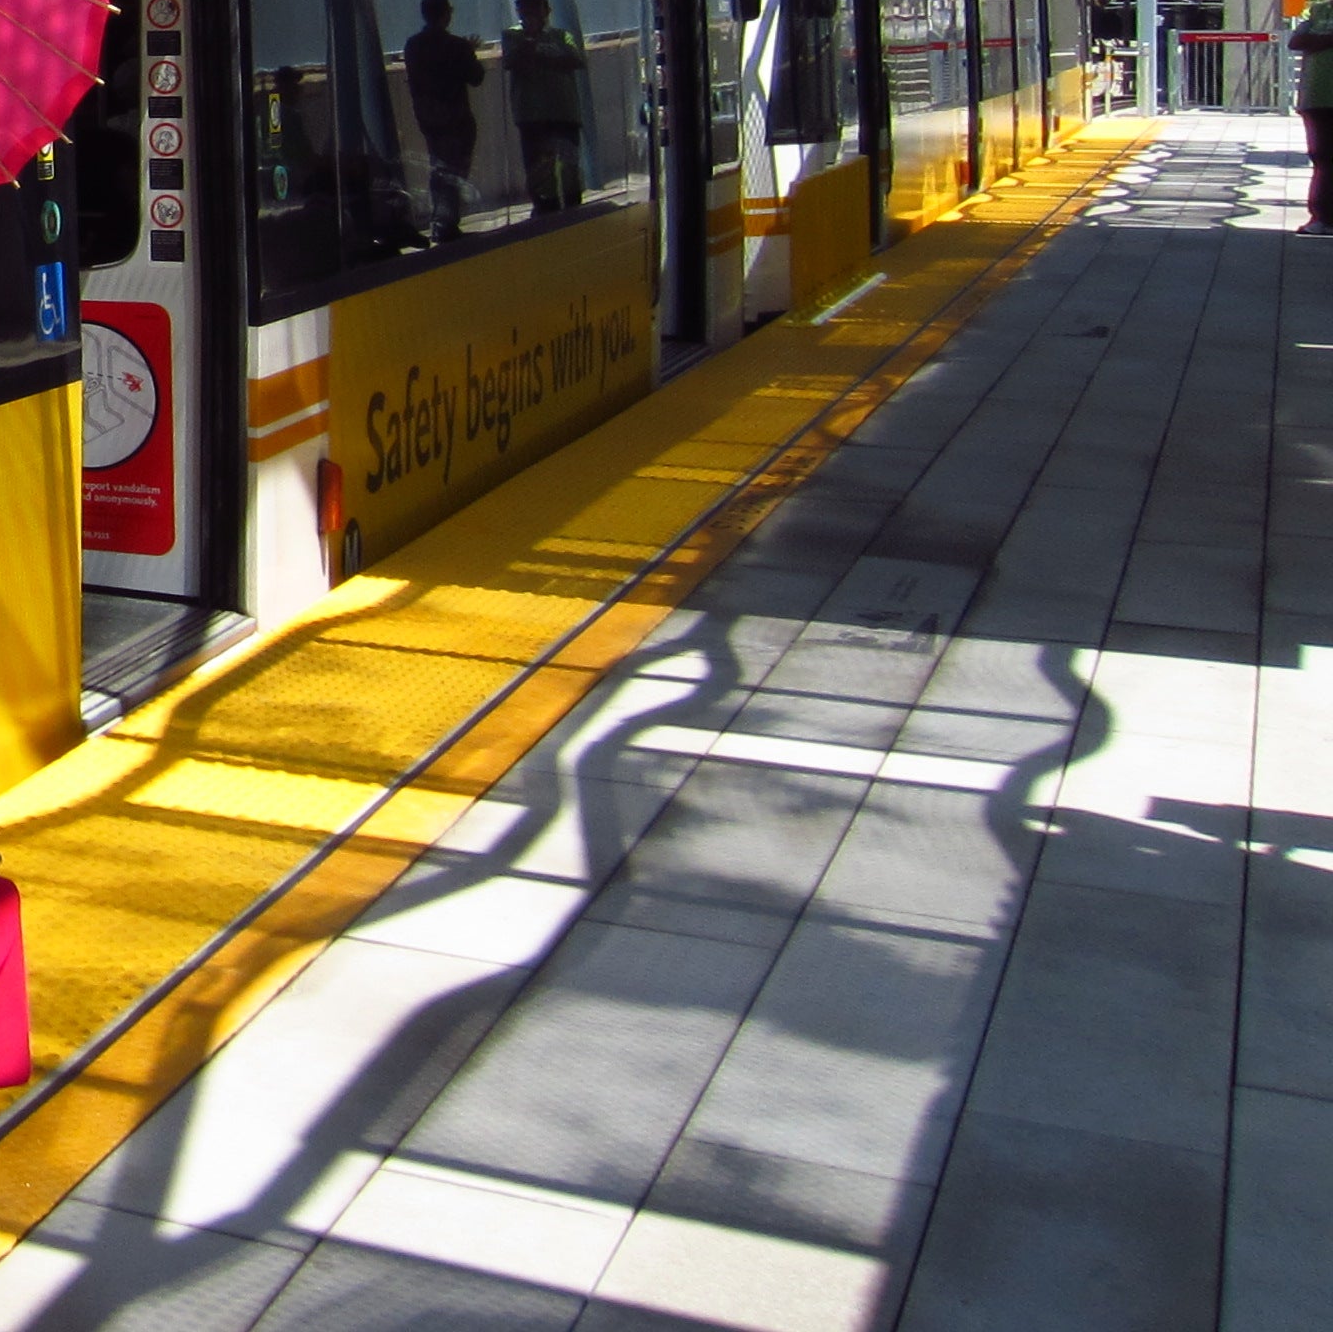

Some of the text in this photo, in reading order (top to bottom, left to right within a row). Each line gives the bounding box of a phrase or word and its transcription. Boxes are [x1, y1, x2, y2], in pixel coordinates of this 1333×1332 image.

[366, 295, 634, 493] Safety begins with you.
[113, 483, 161, 494] vandalism
[94, 494, 158, 507] anonymously.
